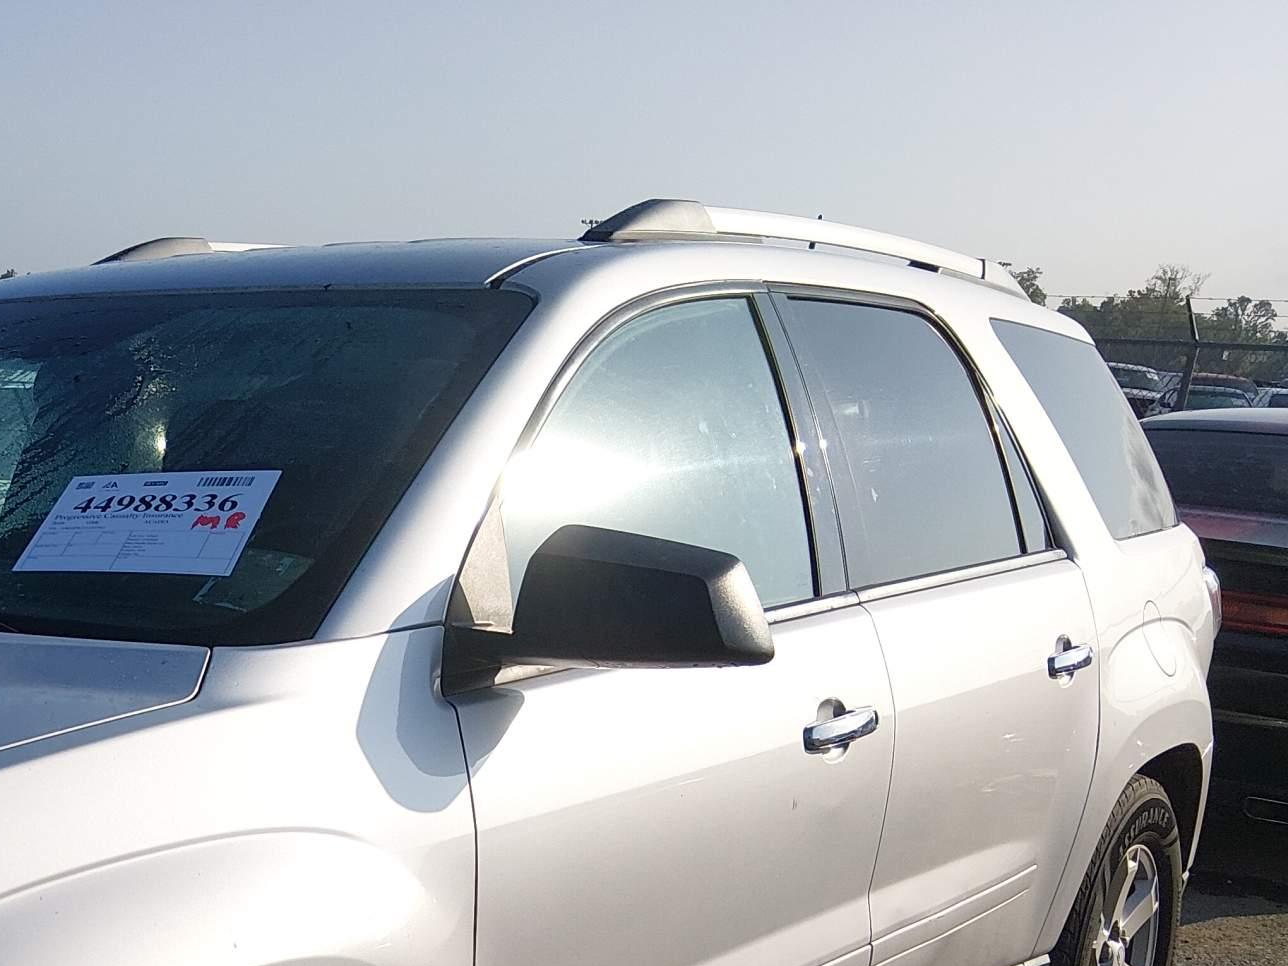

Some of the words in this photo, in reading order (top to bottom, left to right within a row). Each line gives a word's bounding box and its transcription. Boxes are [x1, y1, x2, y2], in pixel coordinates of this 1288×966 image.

[73, 492, 244, 513] 44988336
[54, 513, 102, 521] Progressive
[103, 511, 140, 521] Casualty
[142, 511, 184, 520] Insurance
